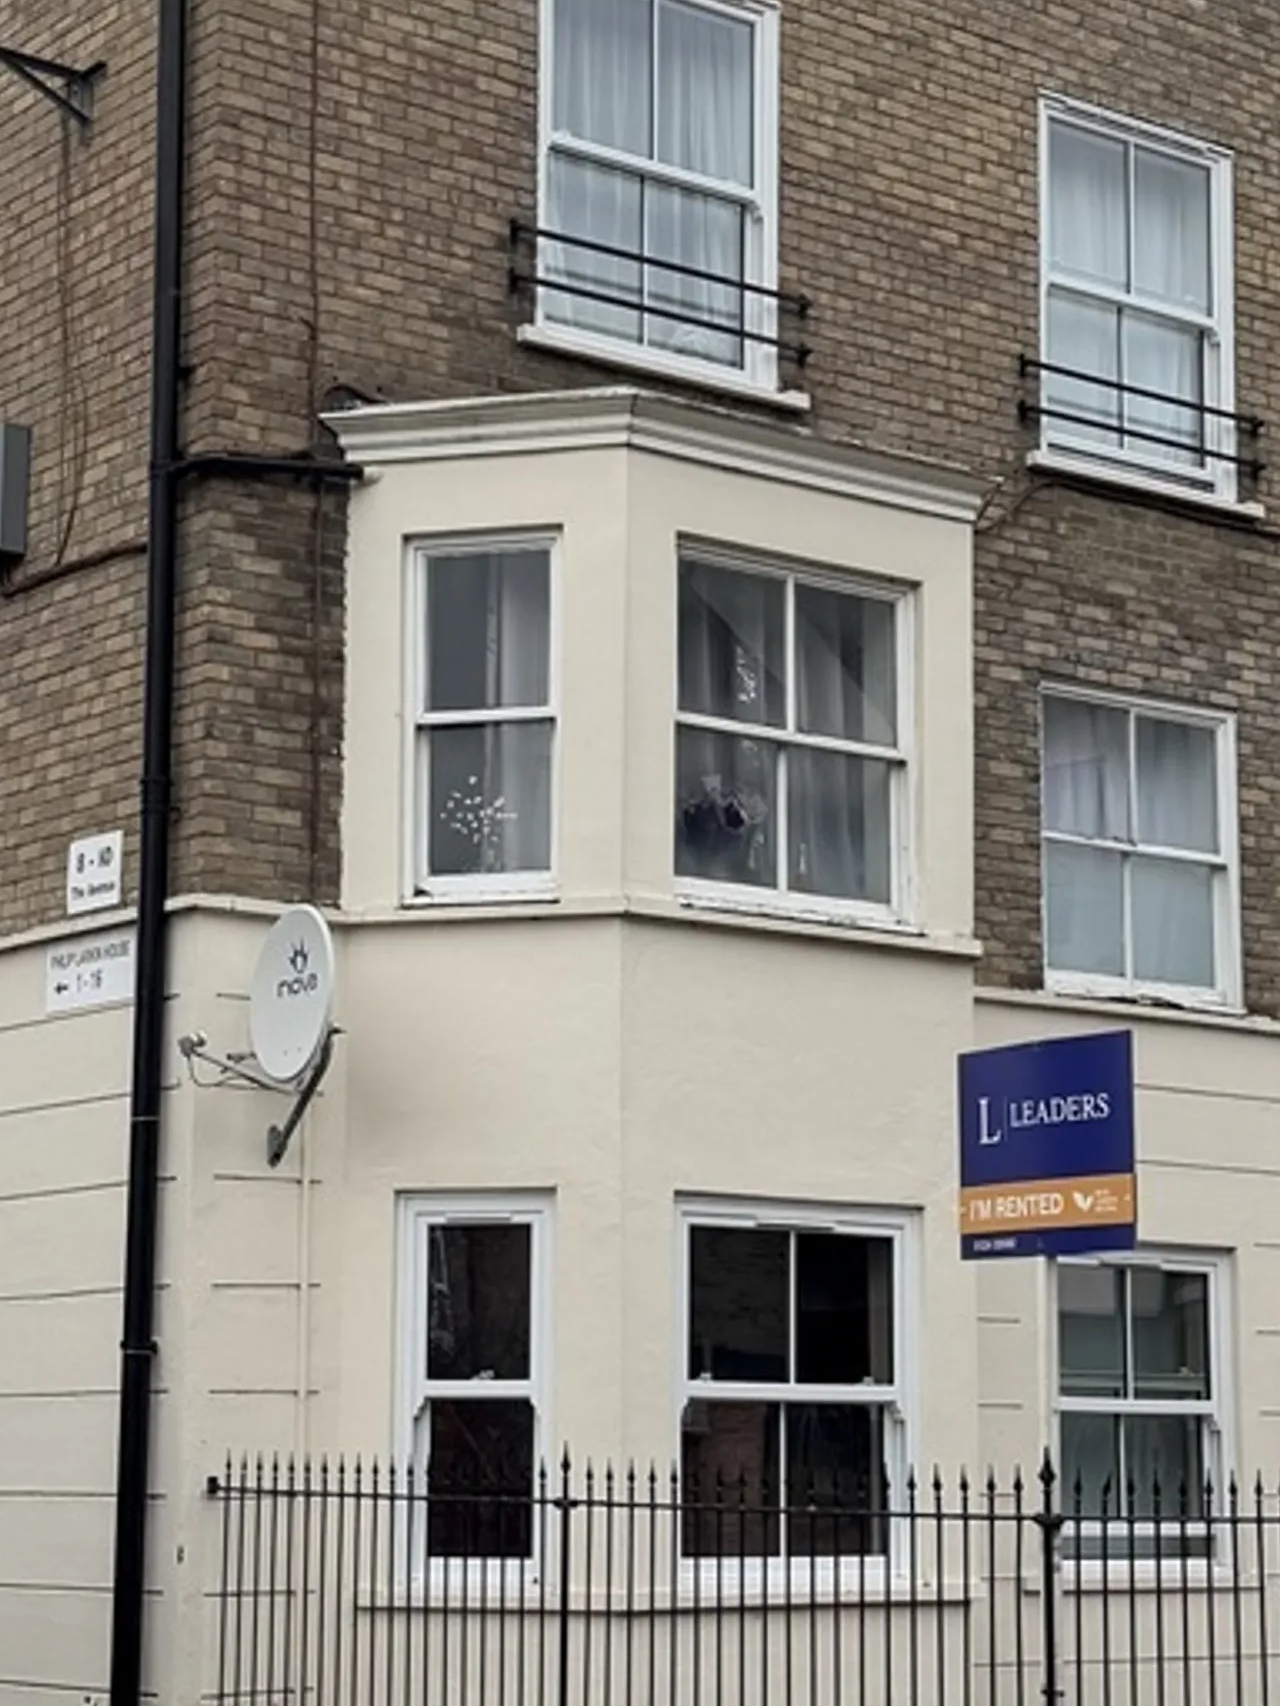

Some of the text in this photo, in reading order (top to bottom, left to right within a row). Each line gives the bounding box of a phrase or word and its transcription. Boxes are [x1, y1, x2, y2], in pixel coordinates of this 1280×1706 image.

[1009, 1092, 1110, 1128] LEADERS
[970, 1192, 1065, 1221] I'M RENTED
